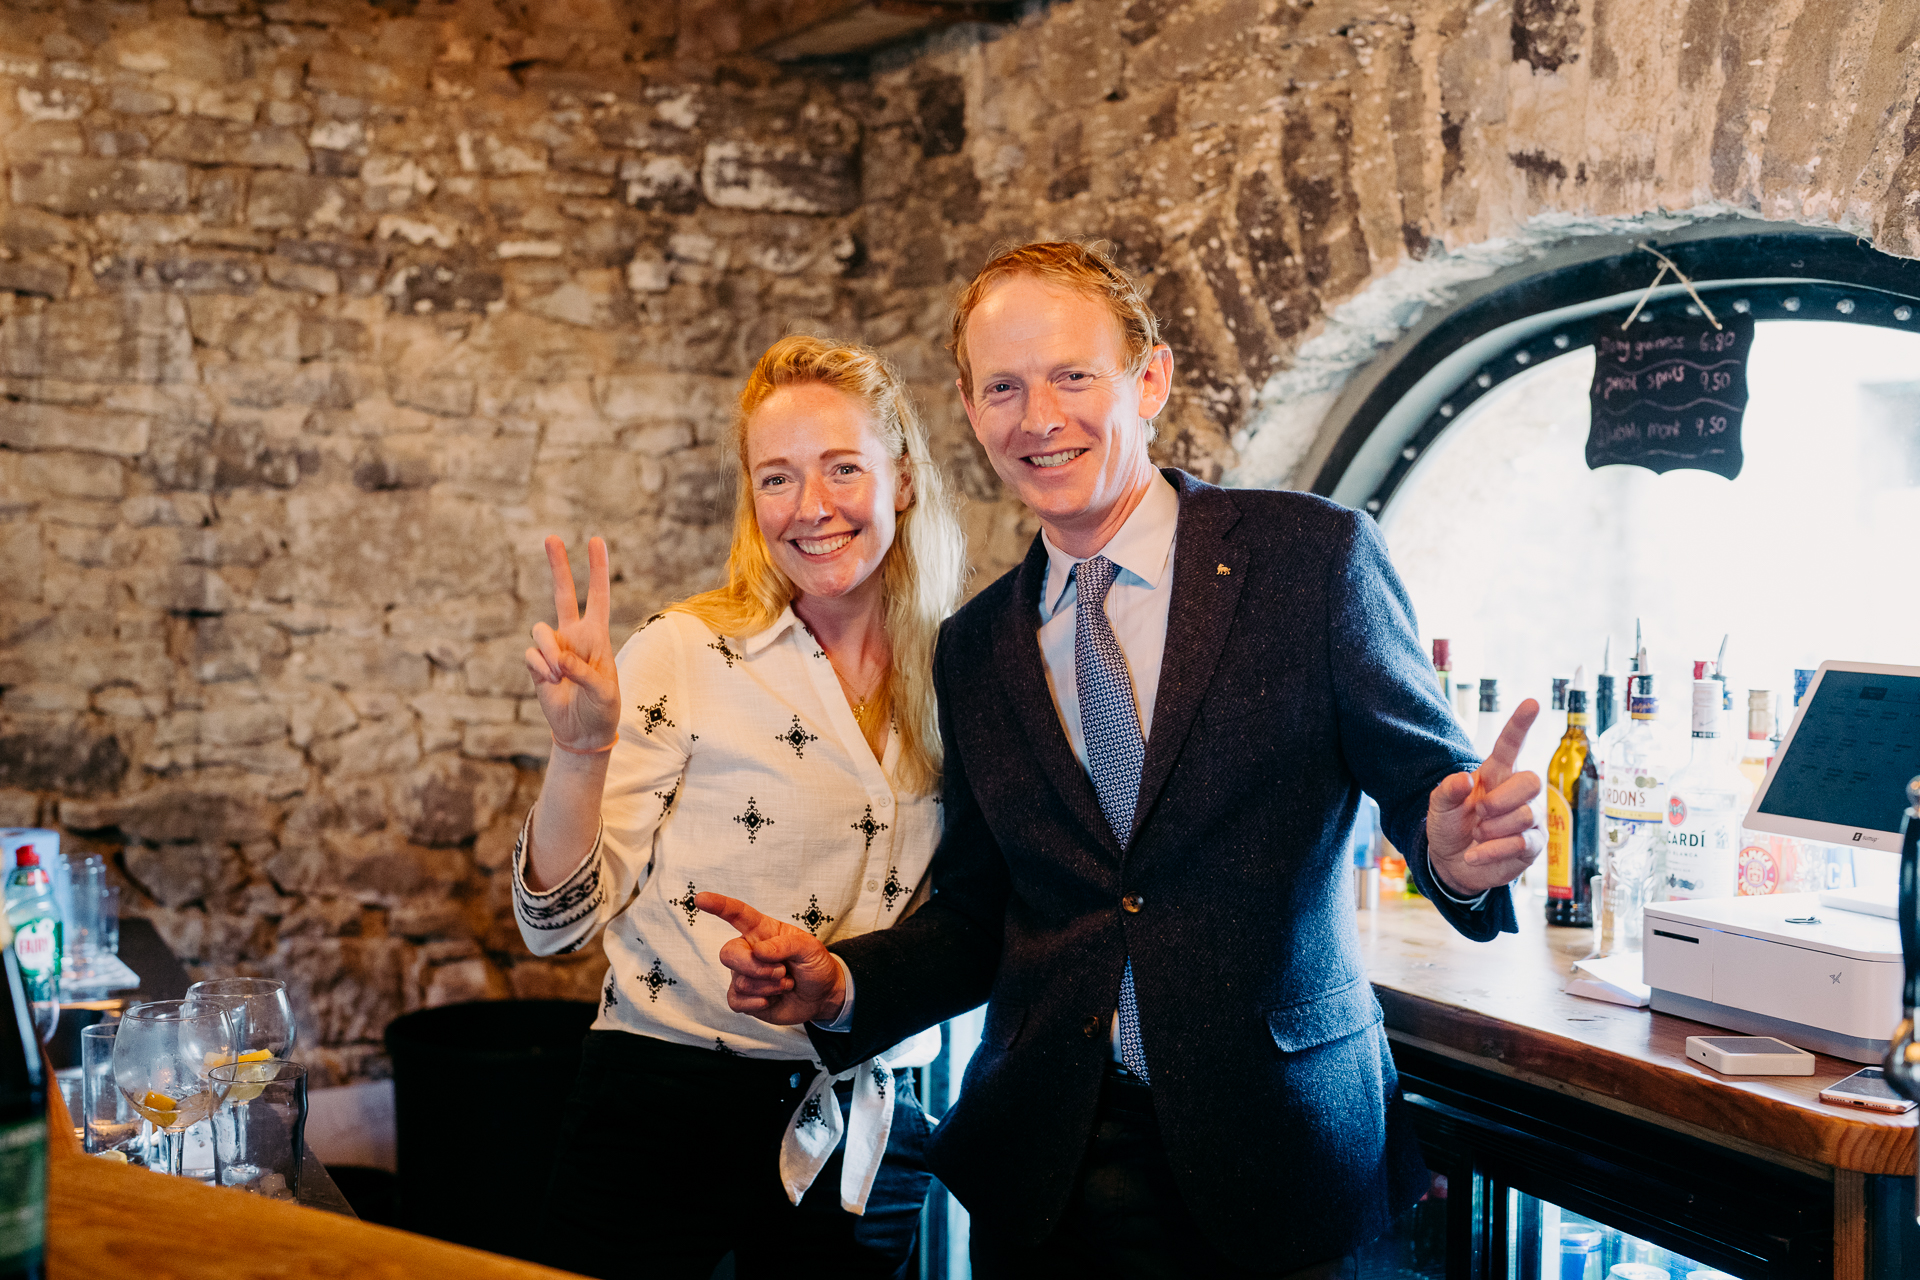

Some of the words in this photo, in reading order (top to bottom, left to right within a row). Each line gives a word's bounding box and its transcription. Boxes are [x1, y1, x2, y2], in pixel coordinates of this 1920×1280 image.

[1700, 331, 1736, 352] 6.80
[1701, 371, 1731, 393] 9.50
[1696, 415, 1728, 437] 9.50
[1739, 850, 1774, 870] OLMECA
[1738, 874, 1775, 896] TEQUILA
